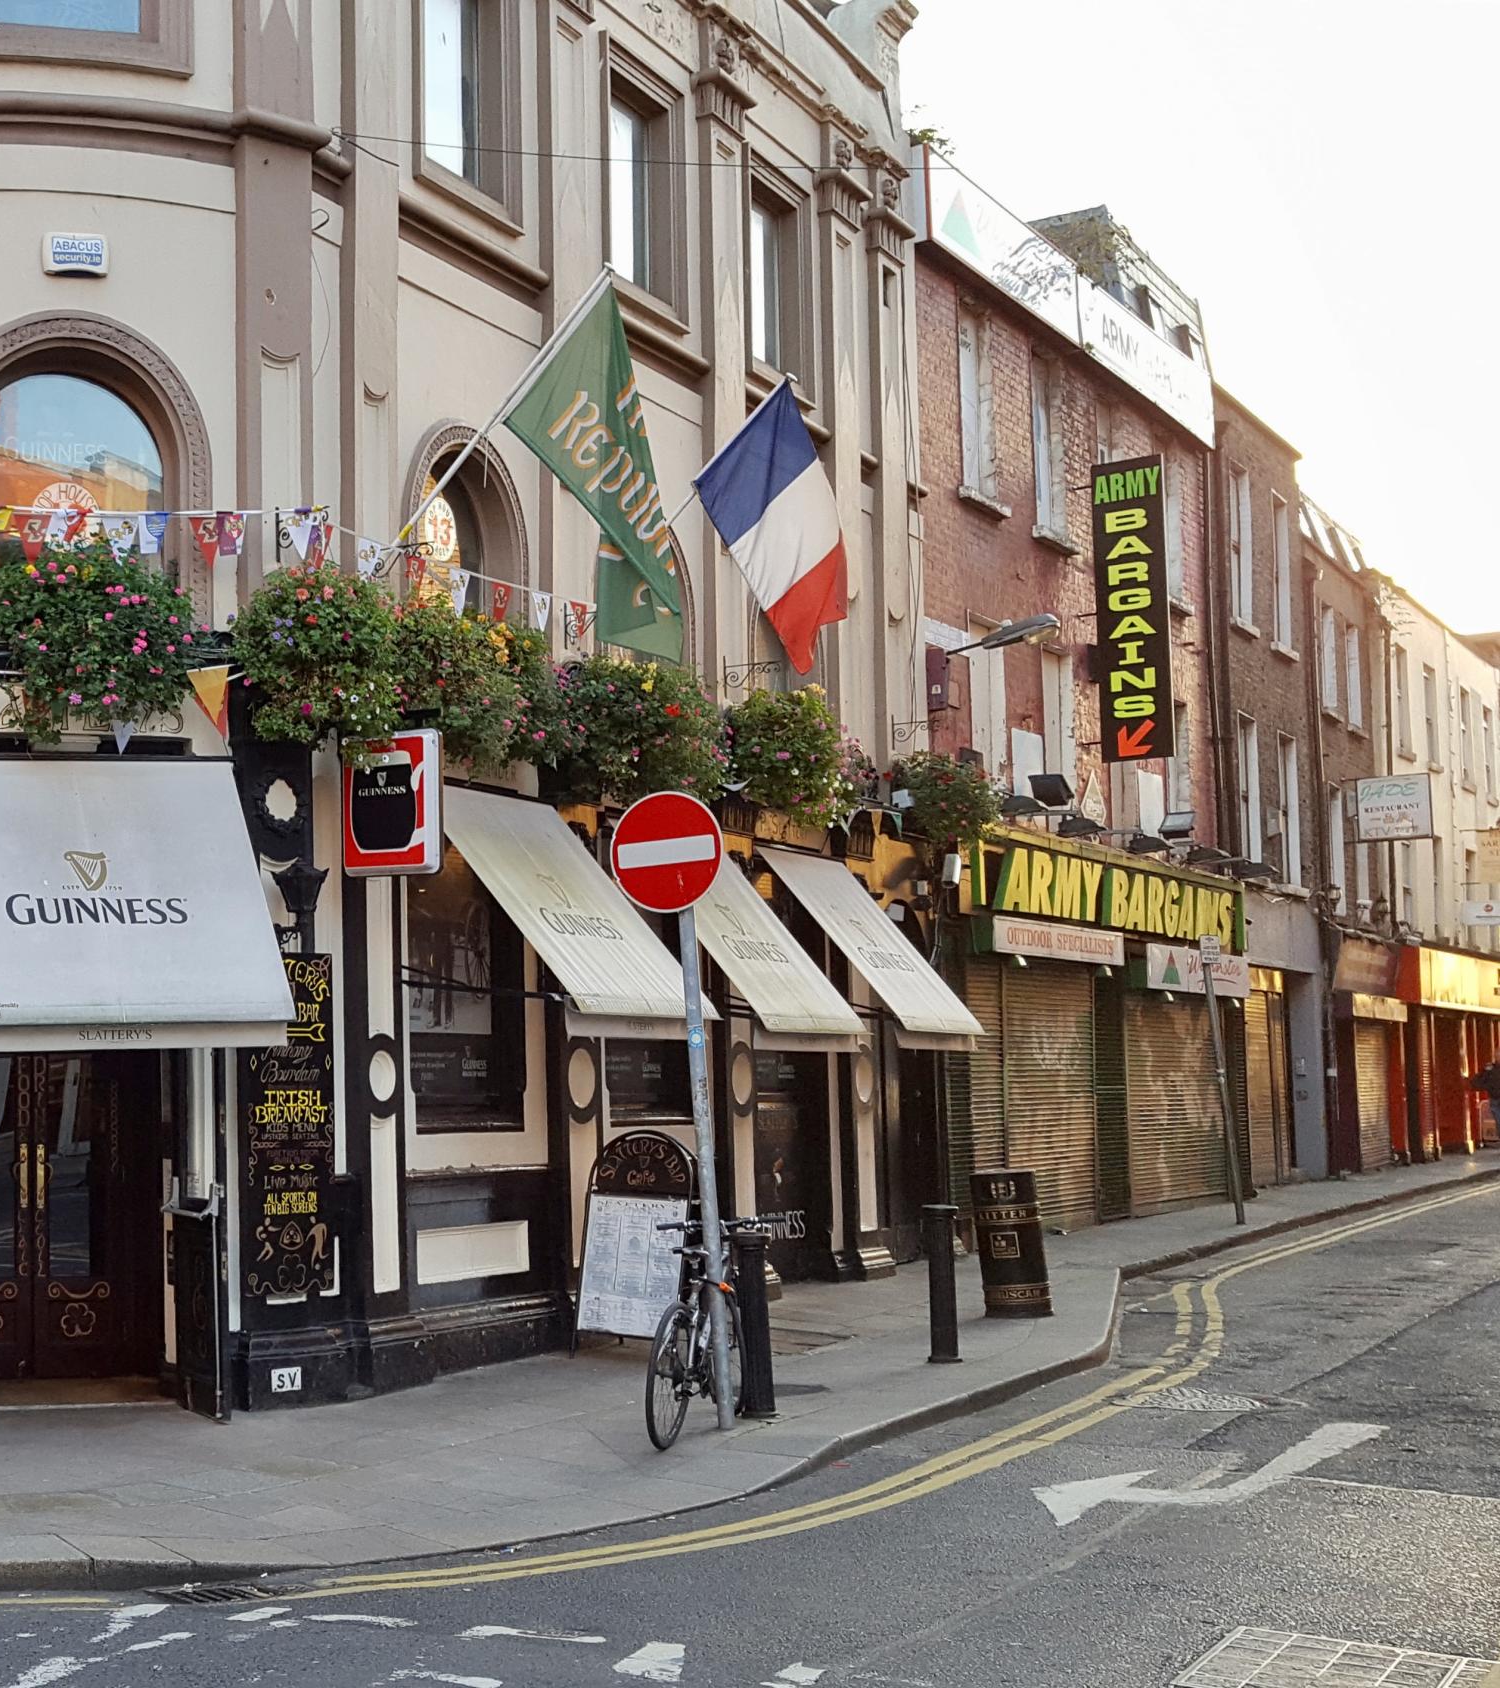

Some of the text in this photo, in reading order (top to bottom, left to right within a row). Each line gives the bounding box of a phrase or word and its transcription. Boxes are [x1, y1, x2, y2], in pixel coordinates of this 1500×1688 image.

[54, 240, 100, 252] ABACUS
[1102, 313, 1140, 368] ARMY
[3, 436, 109, 466] GUINNESS
[1094, 465, 1160, 505] ARMY
[1104, 507, 1157, 719] BARGAINS
[358, 785, 407, 797] GUINNESS
[1364, 802, 1420, 813] RESTAURANT
[1001, 847, 1233, 946] ARMY BARGAINS
[5, 893, 189, 926] GUINNESS
[539, 907, 624, 940] GUINNESS
[721, 934, 790, 964] GUINNESS
[1007, 926, 1115, 957] OUTDOOR SPECIALISTS
[857, 946, 915, 972] GUINNESS
[297, 1002, 320, 1022] BAR
[78, 1028, 153, 1041] SLATTERY'S
[263, 1089, 321, 1107] IRISH
[254, 1105, 328, 1123] BREAKFAST
[266, 1122, 317, 1133] KIDS MENU
[263, 1201, 318, 1216] TEN BIG SCREENS
[266, 1191, 317, 1204] ALL SPORTS ON
